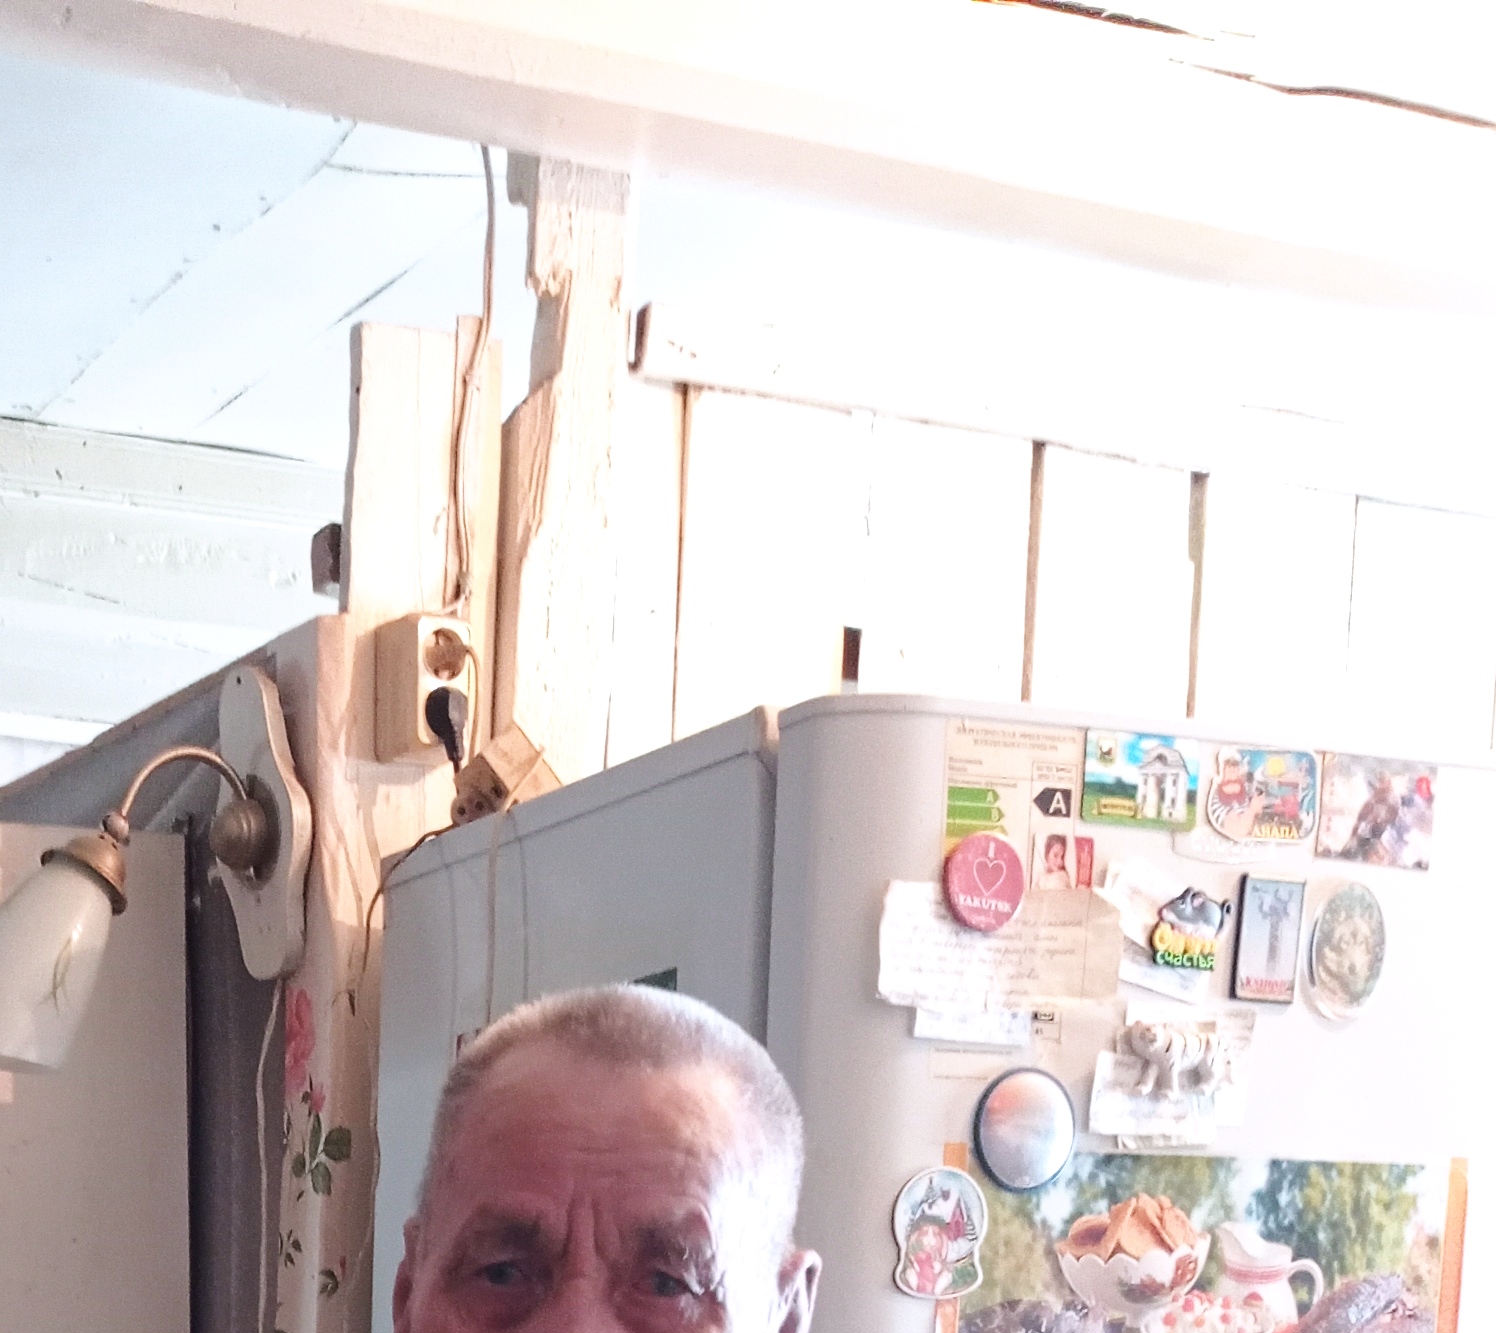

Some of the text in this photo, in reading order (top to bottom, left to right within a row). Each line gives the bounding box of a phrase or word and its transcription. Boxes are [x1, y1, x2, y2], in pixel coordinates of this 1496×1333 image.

[1048, 792, 1067, 815] A
[1252, 823, 1299, 840] АНАПА
[1156, 950, 1216, 970] счастья
